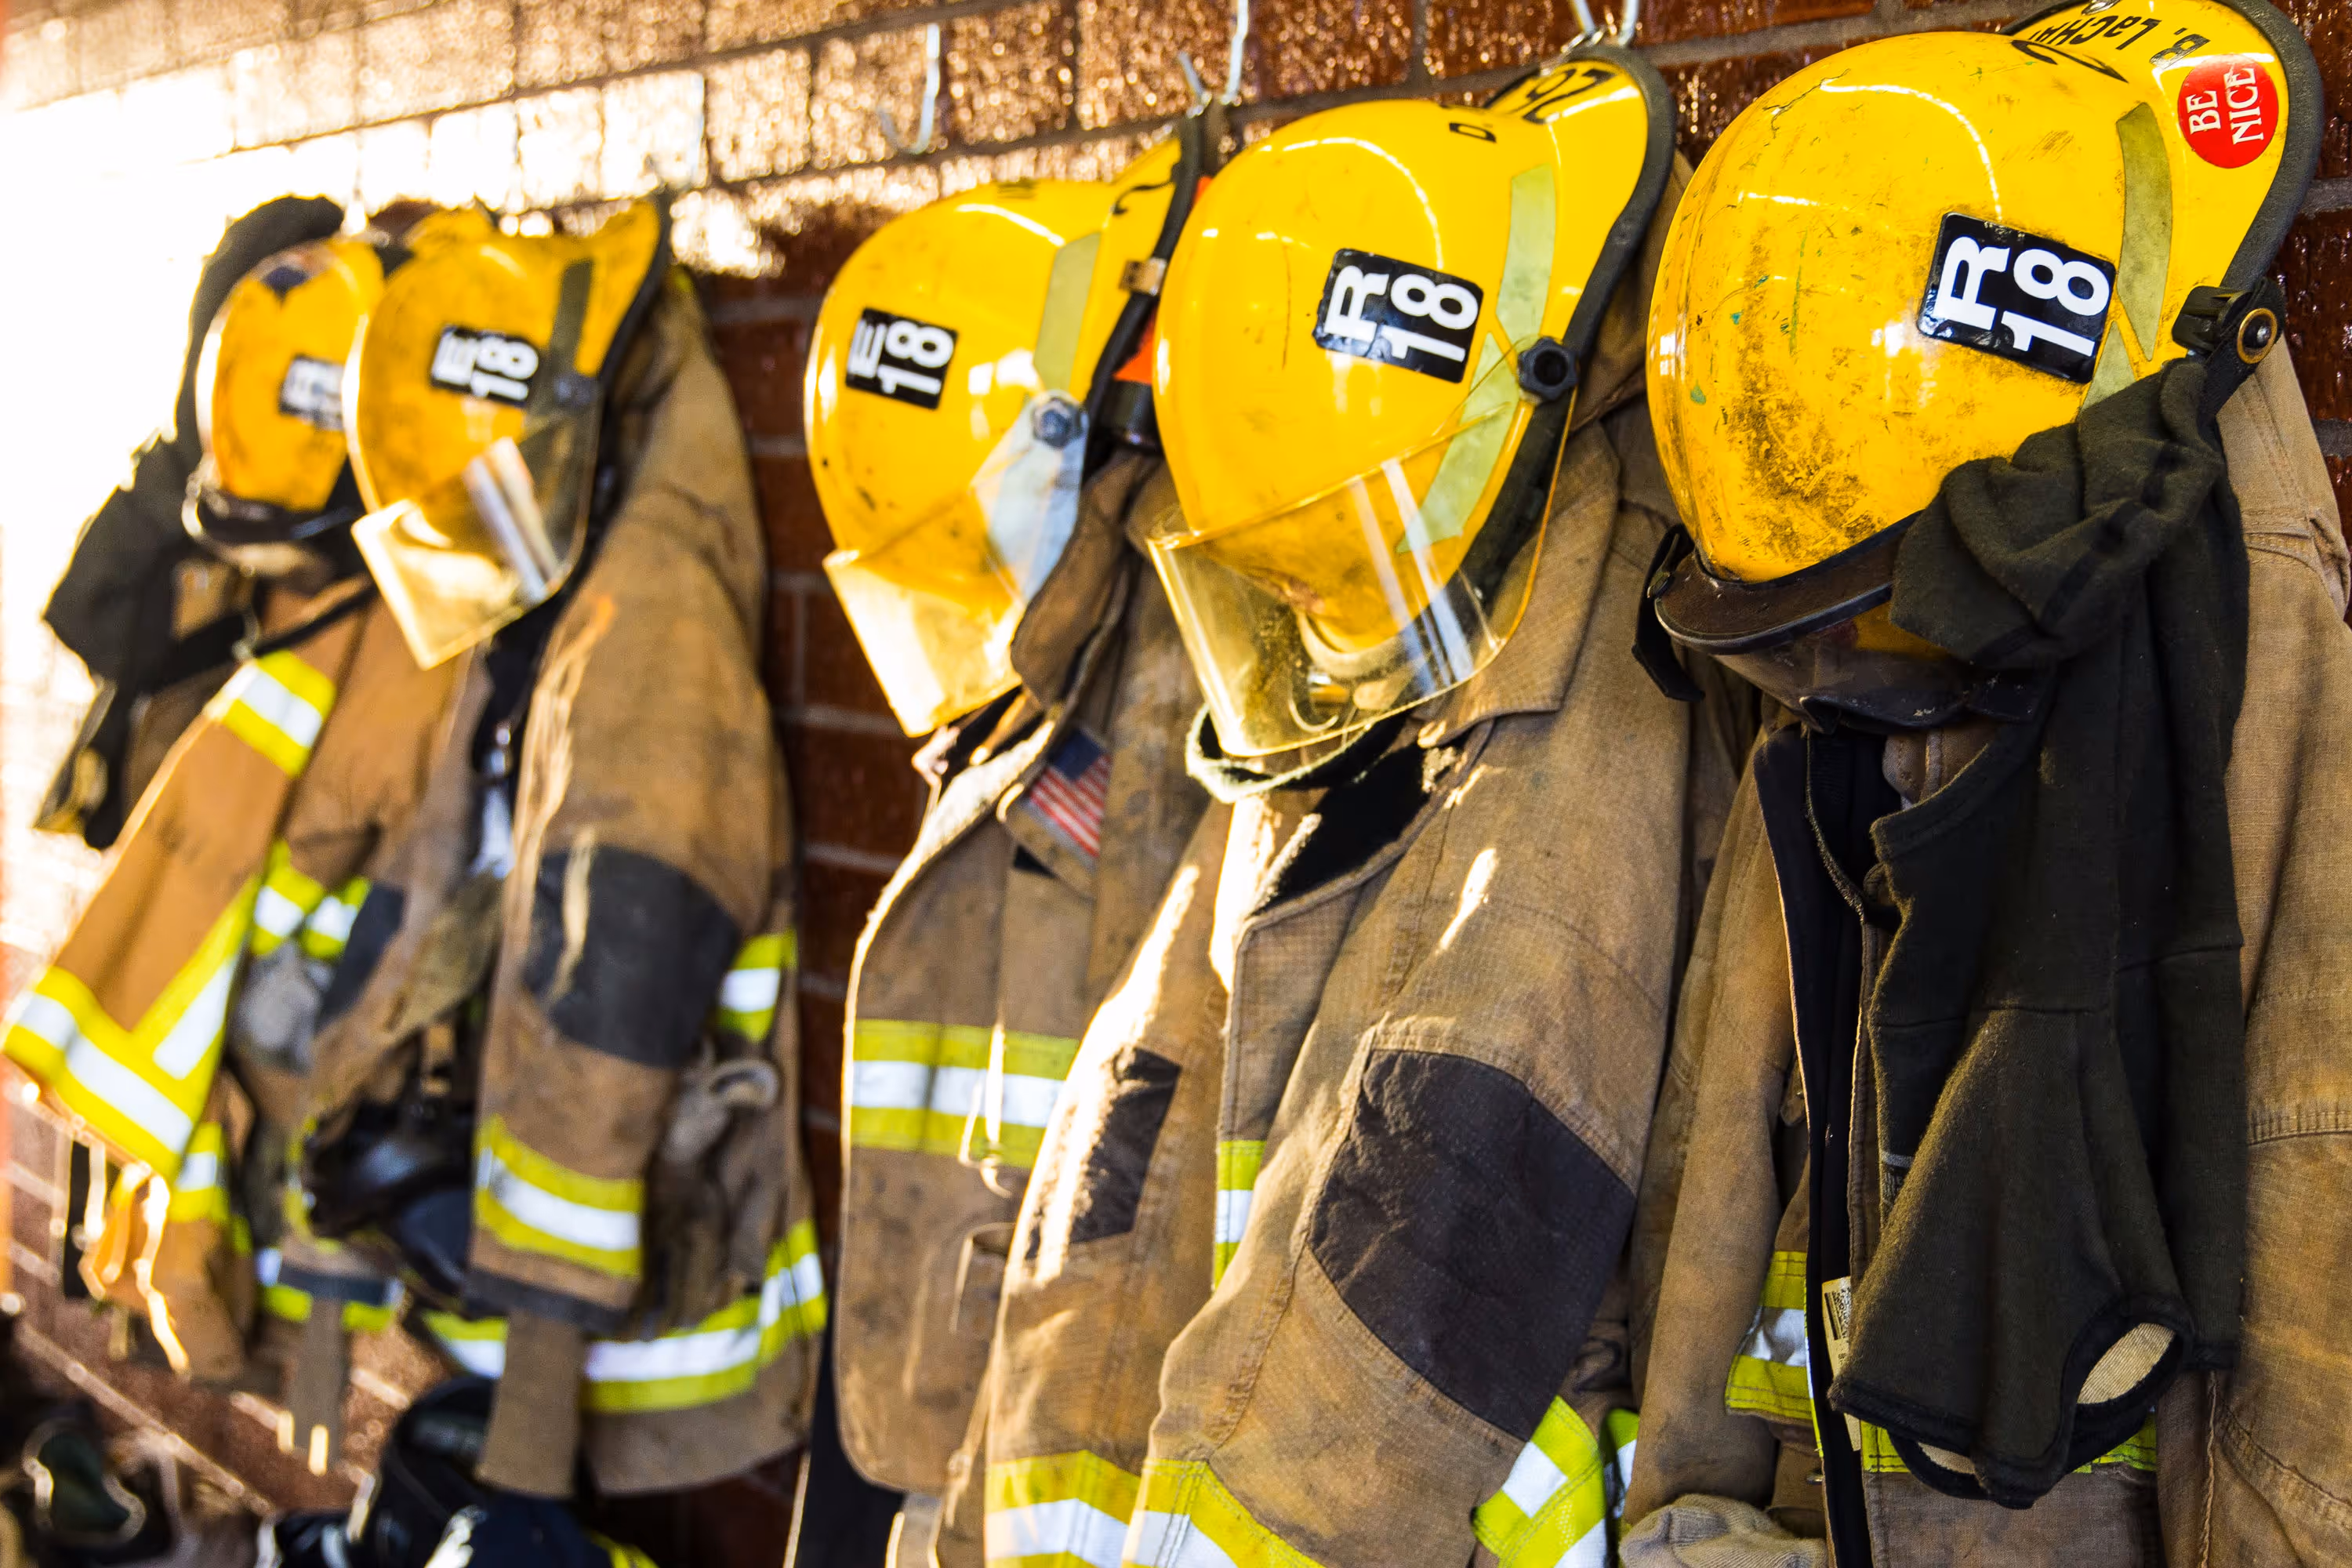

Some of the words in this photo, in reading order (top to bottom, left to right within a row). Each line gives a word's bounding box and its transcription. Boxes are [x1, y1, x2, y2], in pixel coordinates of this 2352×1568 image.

[2028, 16, 2161, 50] LaCHA
[2186, 89, 2221, 136] BE
[2223, 67, 2264, 145] NICE
[1323, 265, 1389, 343] R
[1381, 274, 1479, 363] 18
[1933, 236, 2011, 331] R
[2001, 249, 2110, 357] 18
[471, 336, 539, 401] 18
[847, 319, 887, 379] E
[877, 320, 953, 396] 18
